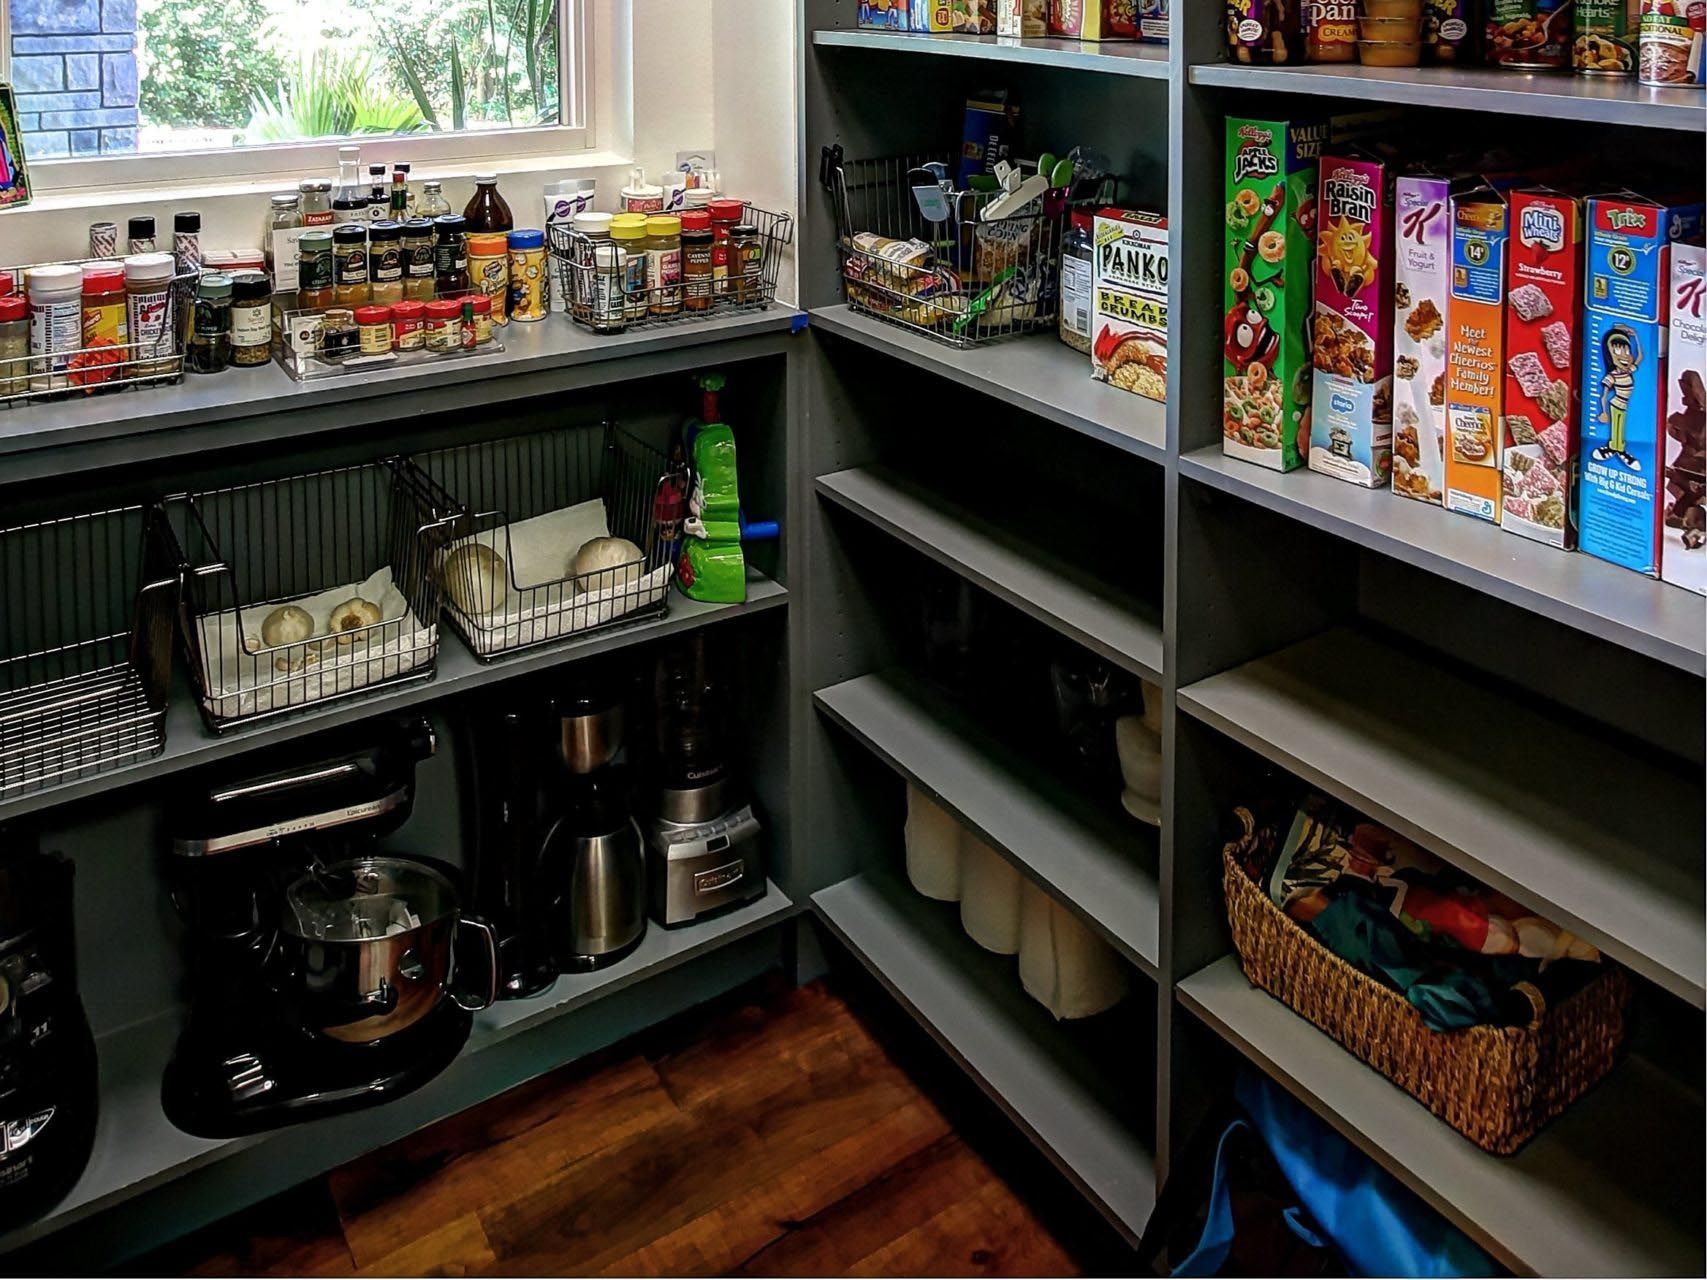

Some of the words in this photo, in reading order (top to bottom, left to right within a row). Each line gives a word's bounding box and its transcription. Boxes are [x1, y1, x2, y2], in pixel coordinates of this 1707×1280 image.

[1576, 6, 1611, 18] Hearts
[1322, 26, 1355, 37] CREAM
[1641, 25, 1684, 36] DITIONAL
[1290, 124, 1328, 144] VALUE
[1243, 147, 1268, 157] APPLE
[1296, 142, 1322, 159] SIZE
[1233, 153, 1279, 184] JACKS
[1332, 167, 1370, 185] Kellogg's
[1325, 178, 1377, 209] Raisin
[1329, 197, 1371, 223] Bran
[1404, 197, 1430, 208] Special
[1402, 202, 1442, 246] K
[1606, 207, 1647, 230] Trix
[1523, 226, 1560, 242] Wheats
[1408, 248, 1427, 260] Fruit
[1428, 251, 1436, 261] &
[1101, 244, 1168, 284] PANKO
[1408, 258, 1436, 271] Yogurt
[1518, 262, 1564, 280] Strawberry
[1678, 265, 1705, 277] Specia
[1100, 291, 1168, 316] BREAD
[1351, 298, 1369, 312] Two
[1101, 301, 1168, 327] CRUMBS
[1460, 324, 1487, 339] Meet
[1680, 330, 1707, 346] Delig
[1453, 341, 1493, 358] Newest
[1449, 352, 1495, 371] Cheerios
[1456, 368, 1490, 386] Family
[1454, 416, 1486, 431] Cheerios
[1608, 467, 1619, 480] UP
[1619, 471, 1648, 489] STRONG
[1615, 481, 1626, 494] Kid
